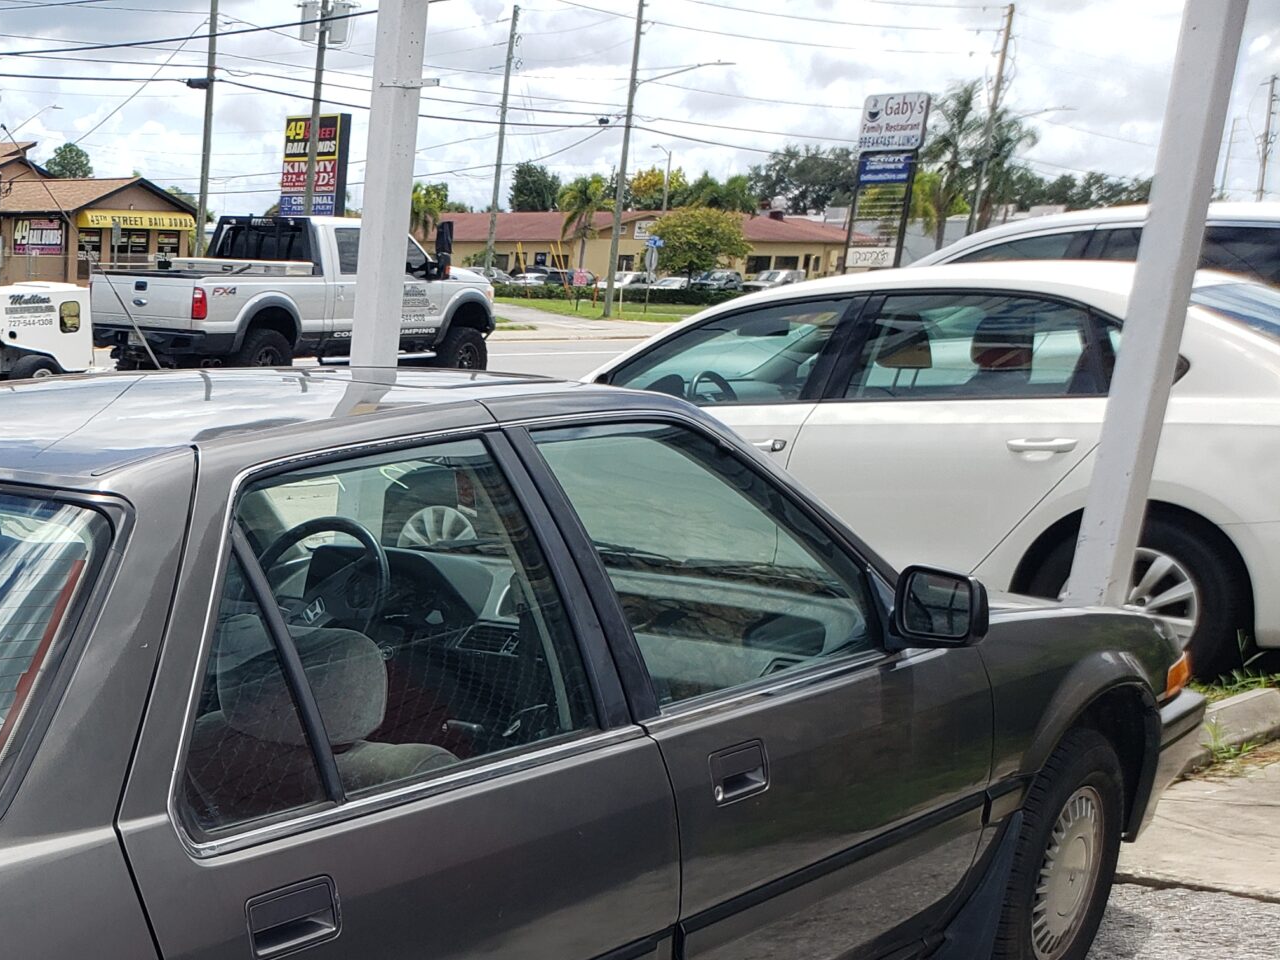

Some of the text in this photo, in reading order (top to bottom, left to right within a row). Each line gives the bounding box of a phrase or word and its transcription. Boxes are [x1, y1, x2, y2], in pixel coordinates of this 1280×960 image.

[885, 95, 924, 123] Gaby's
[286, 122, 305, 139] 49
[863, 122, 920, 135] Family Restaurant
[286, 141, 336, 153] BAIL NDS
[149, 217, 166, 227] BAIL
[14, 220, 30, 245] 49
[212, 286, 237, 296] FX4
